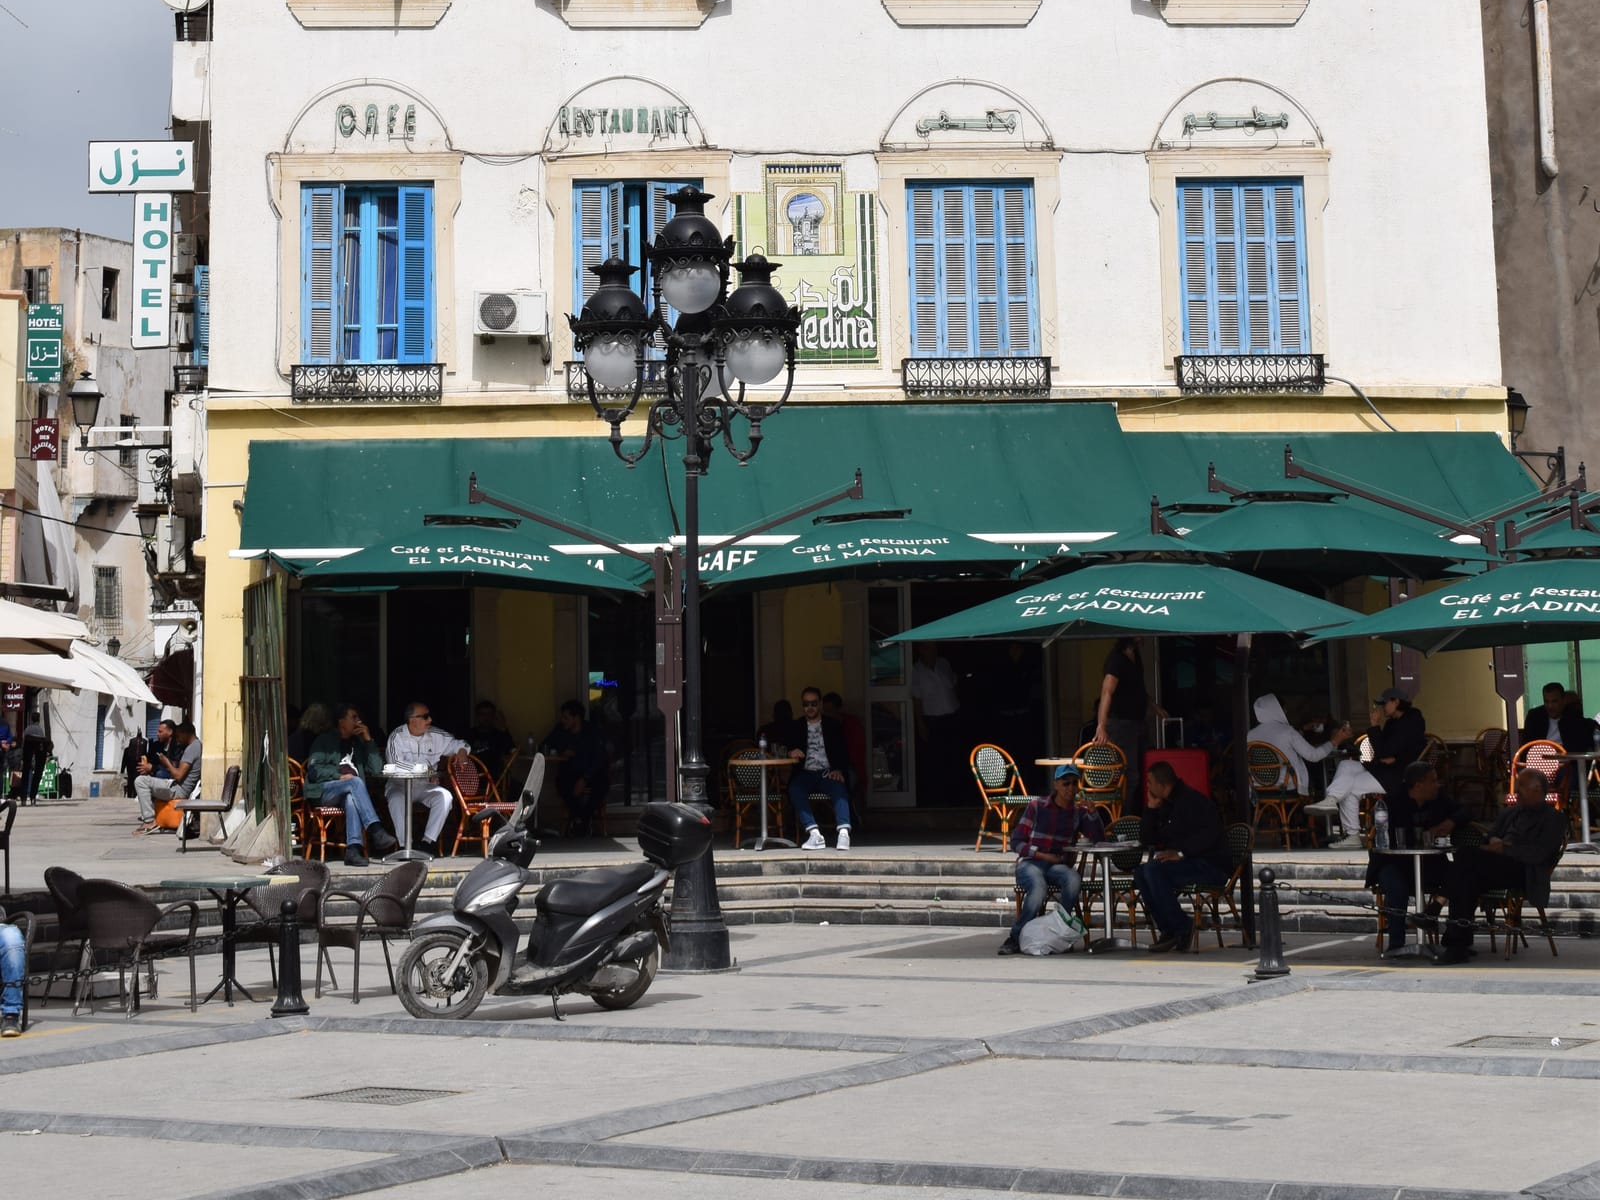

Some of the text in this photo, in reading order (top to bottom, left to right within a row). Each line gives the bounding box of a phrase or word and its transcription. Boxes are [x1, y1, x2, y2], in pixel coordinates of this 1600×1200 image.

[559, 106, 691, 135] RESTAURANT
[99, 147, 186, 186] نزل
[141, 202, 168, 337] HOTEL
[28, 318, 61, 328] HOTEL
[796, 287, 876, 349] edina
[30, 345, 58, 362] نزل
[35, 425, 55, 434] HOTEL
[391, 545, 431, 554] Café
[460, 544, 551, 562] Restaurant
[791, 544, 831, 554] Café
[859, 537, 950, 546] Restaurant
[408, 555, 533, 571] EL MADINA
[812, 547, 936, 563] EL MADINA
[1015, 587, 1206, 605] Café et Restaurant
[1439, 593, 1492, 606] Café
[1499, 591, 1522, 601] et
[1020, 599, 1170, 617] EL MADINA
[1452, 600, 1600, 620] EL MADIN
